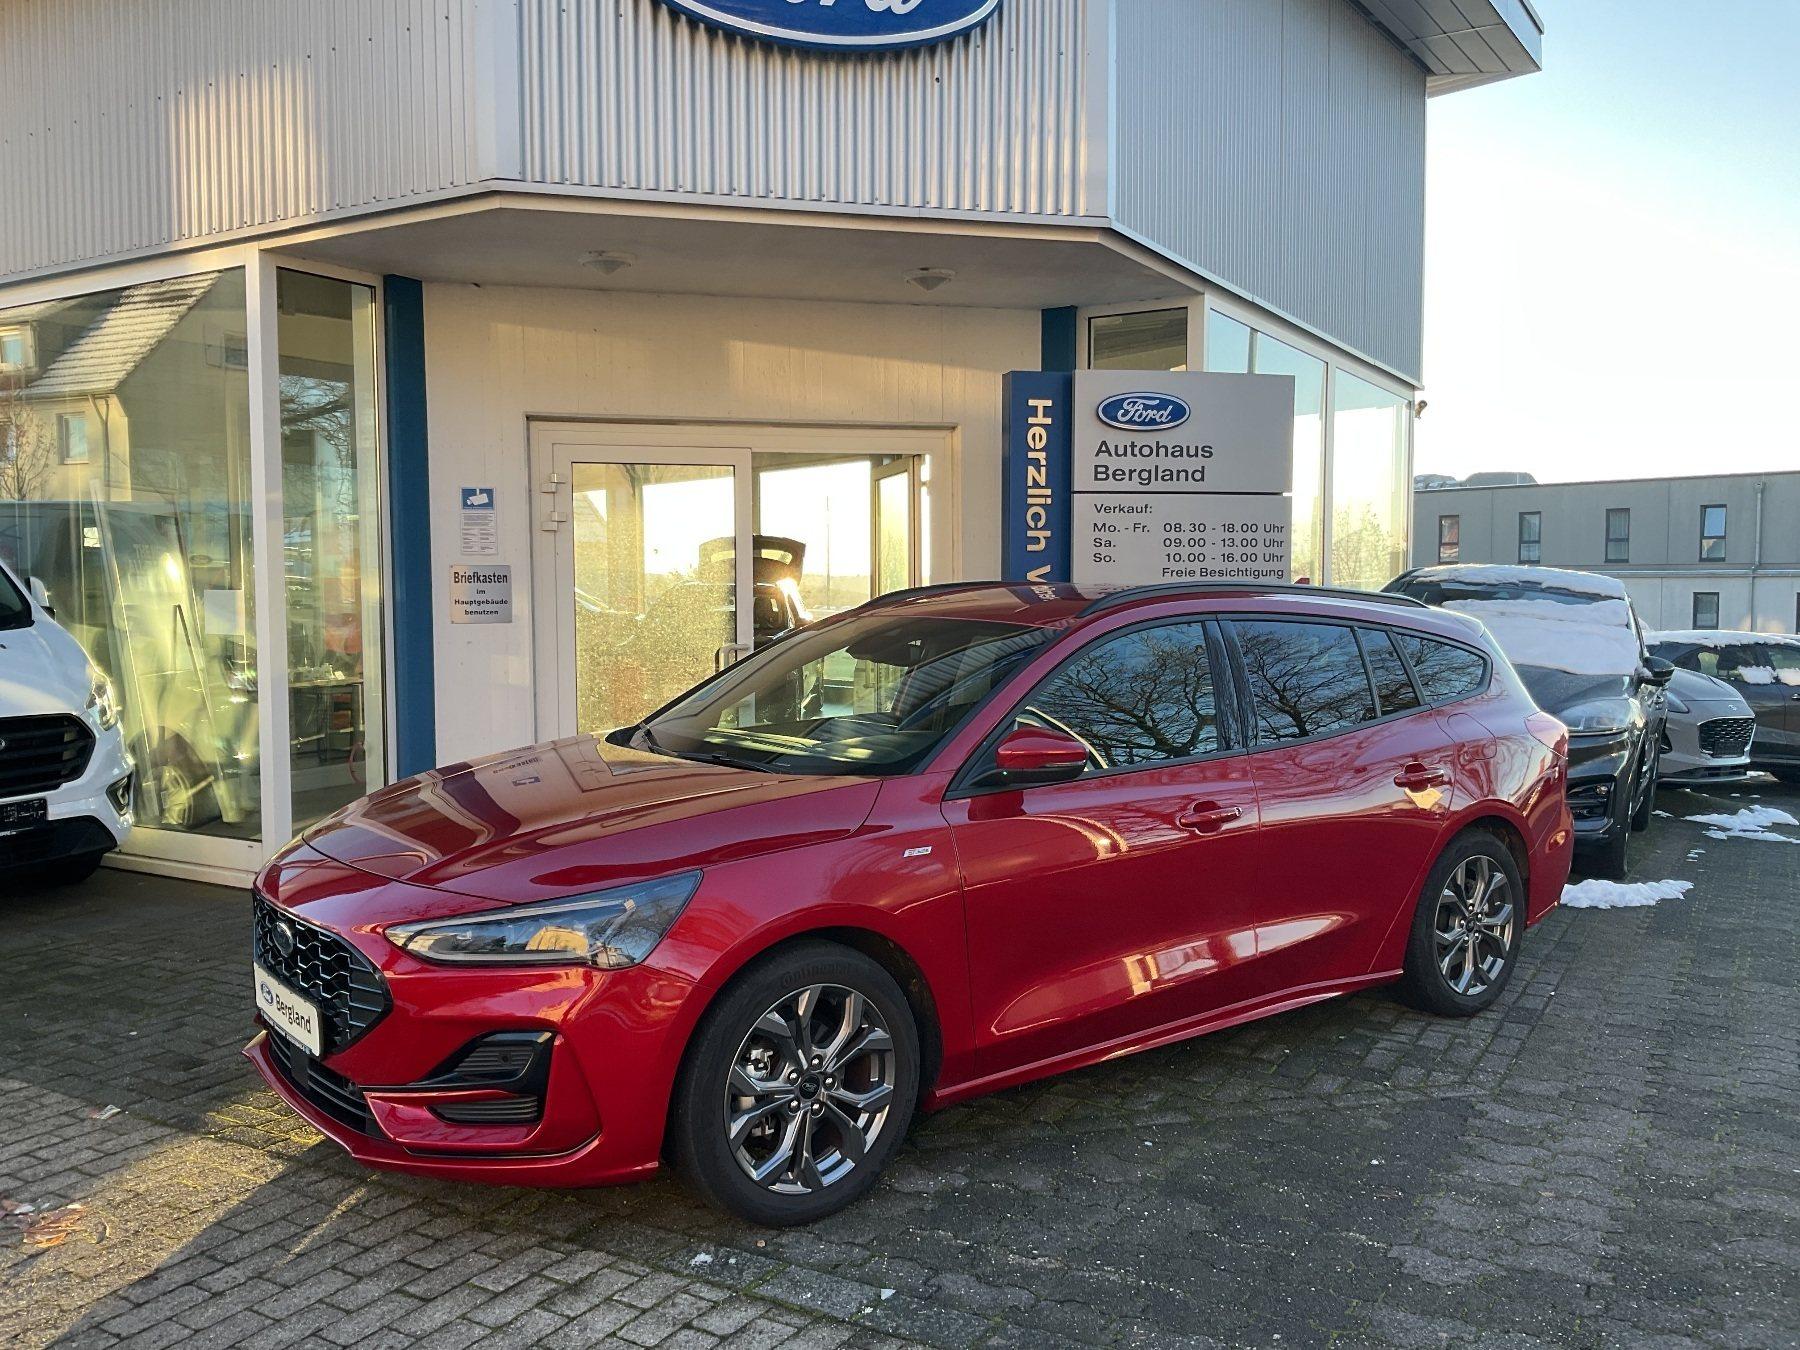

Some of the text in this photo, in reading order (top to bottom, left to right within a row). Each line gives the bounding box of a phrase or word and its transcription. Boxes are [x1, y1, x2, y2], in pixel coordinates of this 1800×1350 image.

[1117, 398, 1173, 423] Ford
[1094, 440, 1214, 459] Autohaus
[1026, 398, 1053, 552] Herzlich
[1093, 464, 1206, 486] Bergland
[1093, 503, 1153, 514] Verkauf:
[1093, 522, 1121, 533] Mo.
[1133, 522, 1150, 533] Fr.
[1163, 522, 1207, 533] 08.30
[1220, 522, 1259, 533] 18.00
[1263, 523, 1285, 534] Uhr
[1092, 537, 1117, 548] Sa.
[1163, 537, 1207, 548] 09.00
[1220, 537, 1259, 548] 13.00
[1263, 538, 1285, 548] Uhr
[1092, 552, 1116, 563] So.
[1164, 552, 1206, 563] 10.00
[1220, 552, 1258, 563] 16.00
[1263, 552, 1285, 563] Uhr
[453, 571, 508, 584] Briefkasten
[1162, 567, 1284, 580] Freie Besichtigung
[454, 598, 509, 606] Hauptgebäude
[275, 993, 311, 1034] Bergland
